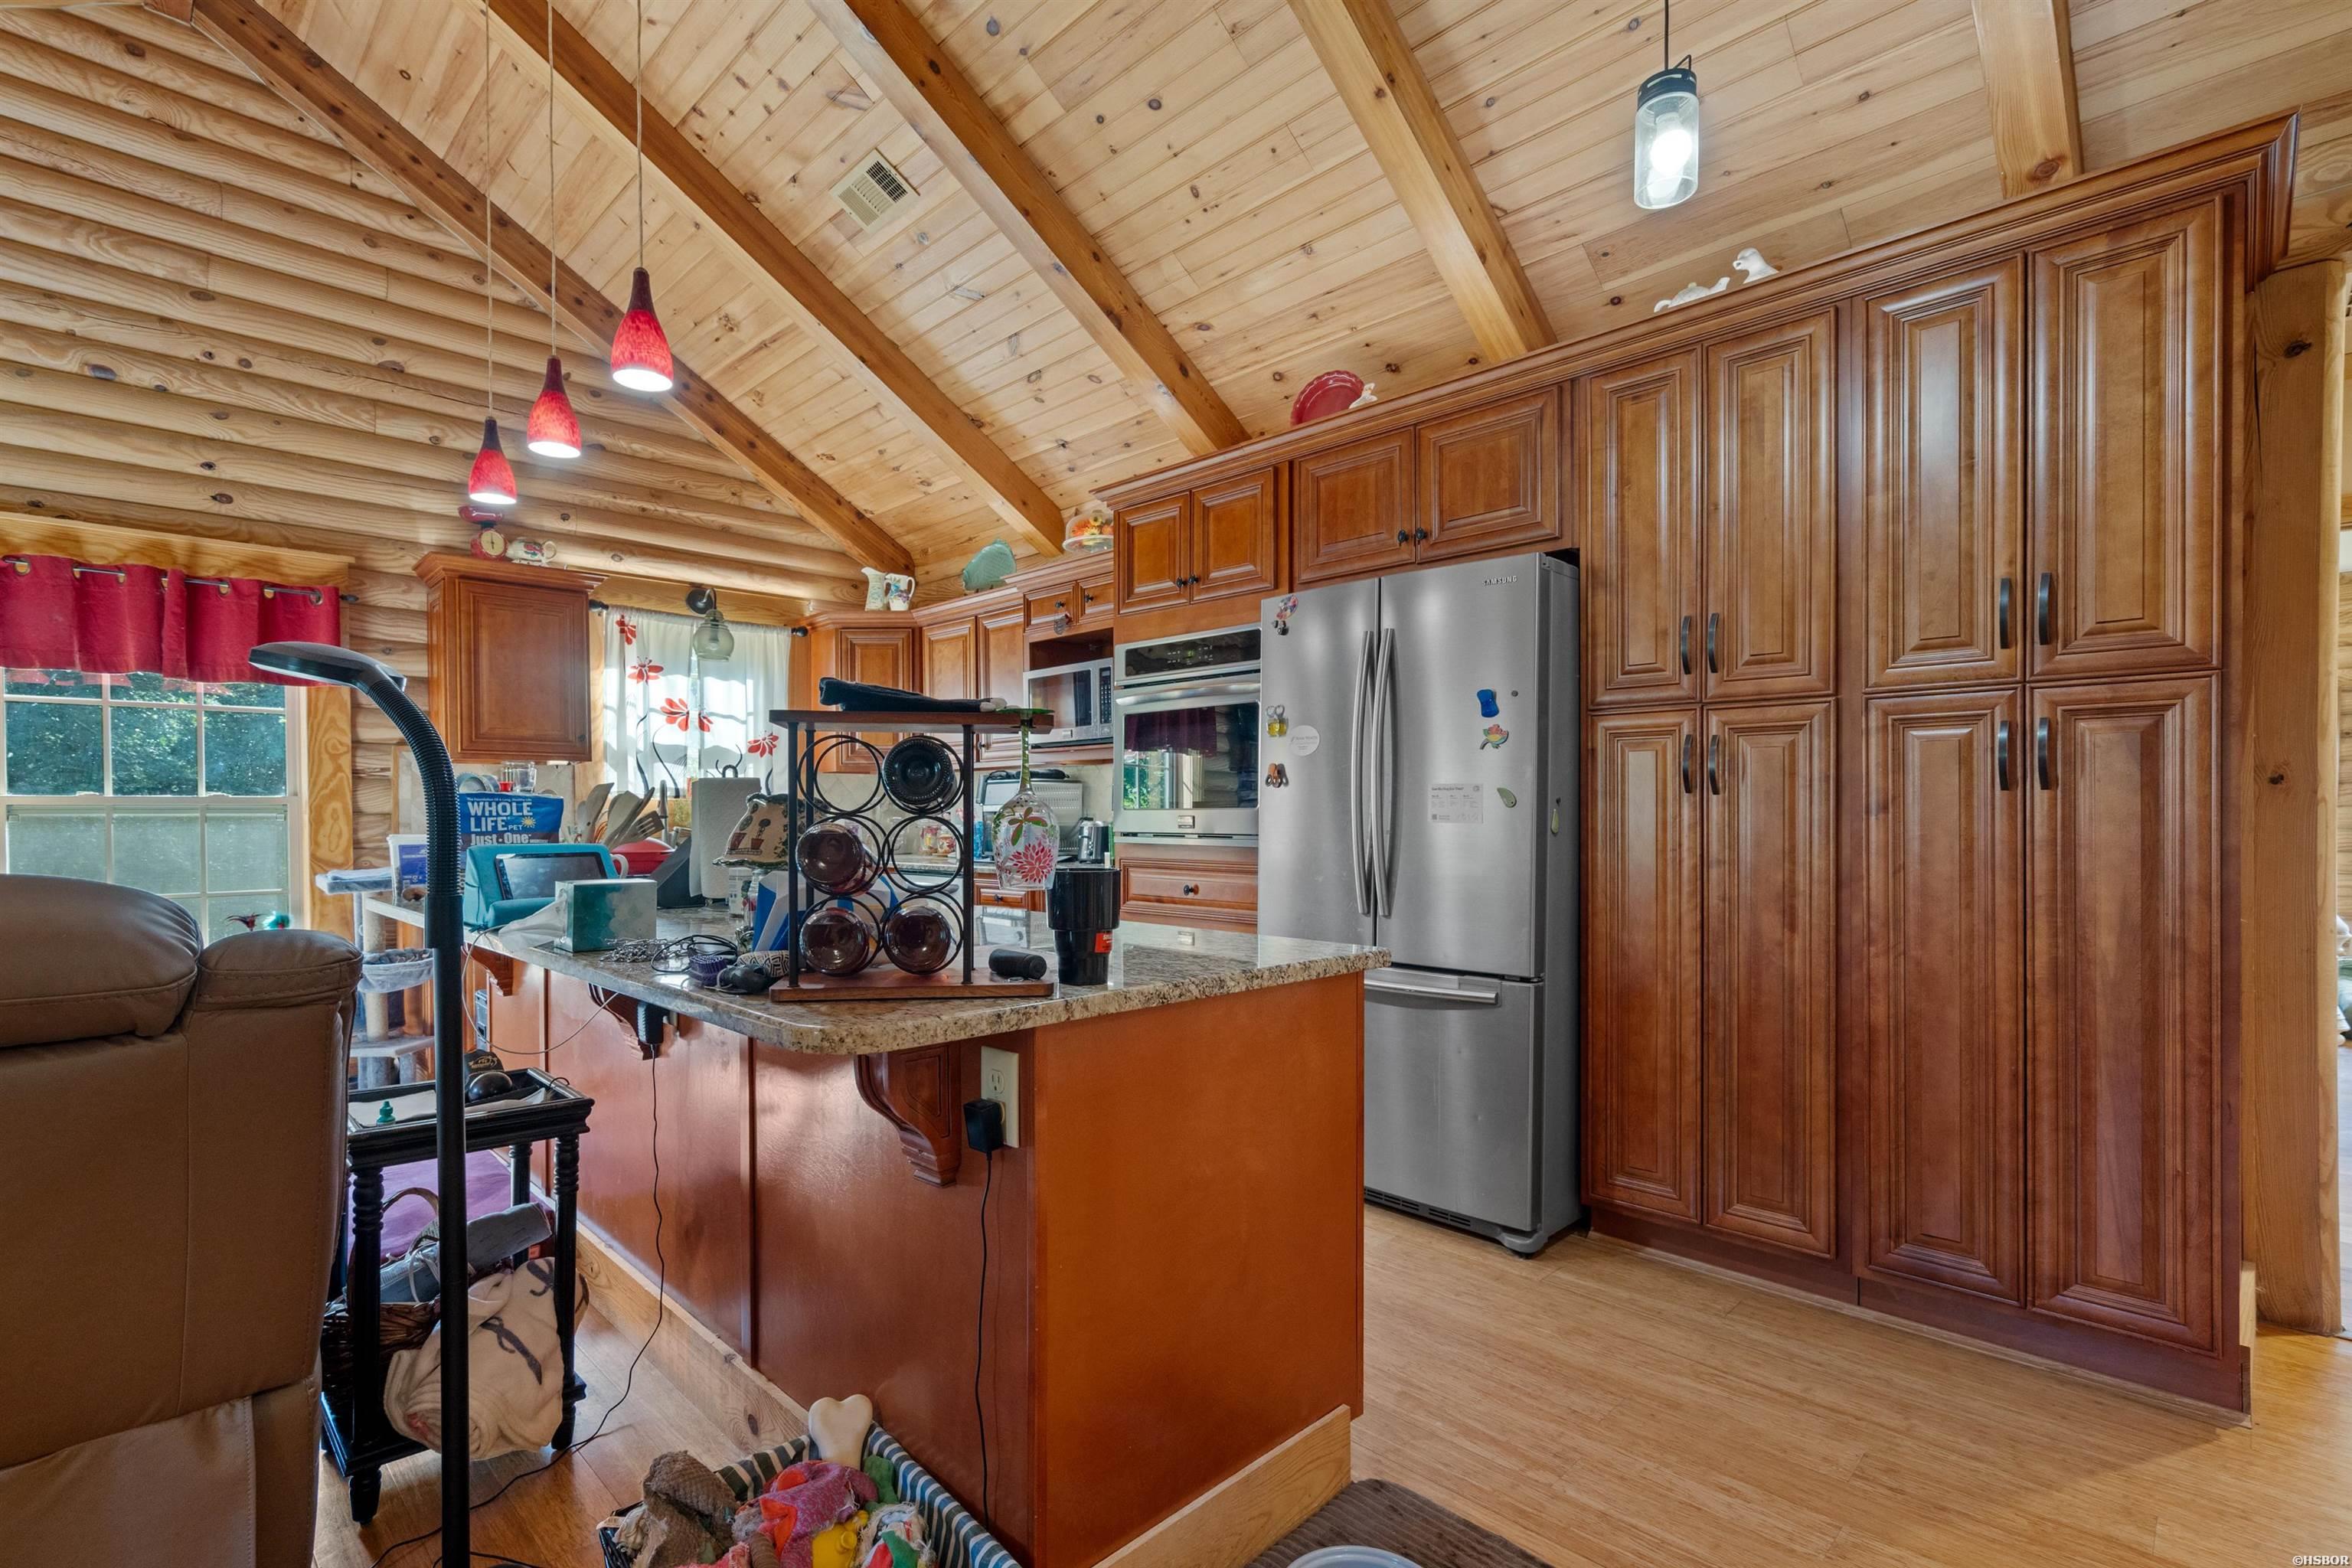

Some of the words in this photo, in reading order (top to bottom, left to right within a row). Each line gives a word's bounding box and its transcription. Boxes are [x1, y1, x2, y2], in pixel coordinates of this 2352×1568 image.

[1481, 575, 1517, 586] SAMSUNG
[467, 802, 533, 816] WHOLE
[470, 816, 508, 831] LIFE
